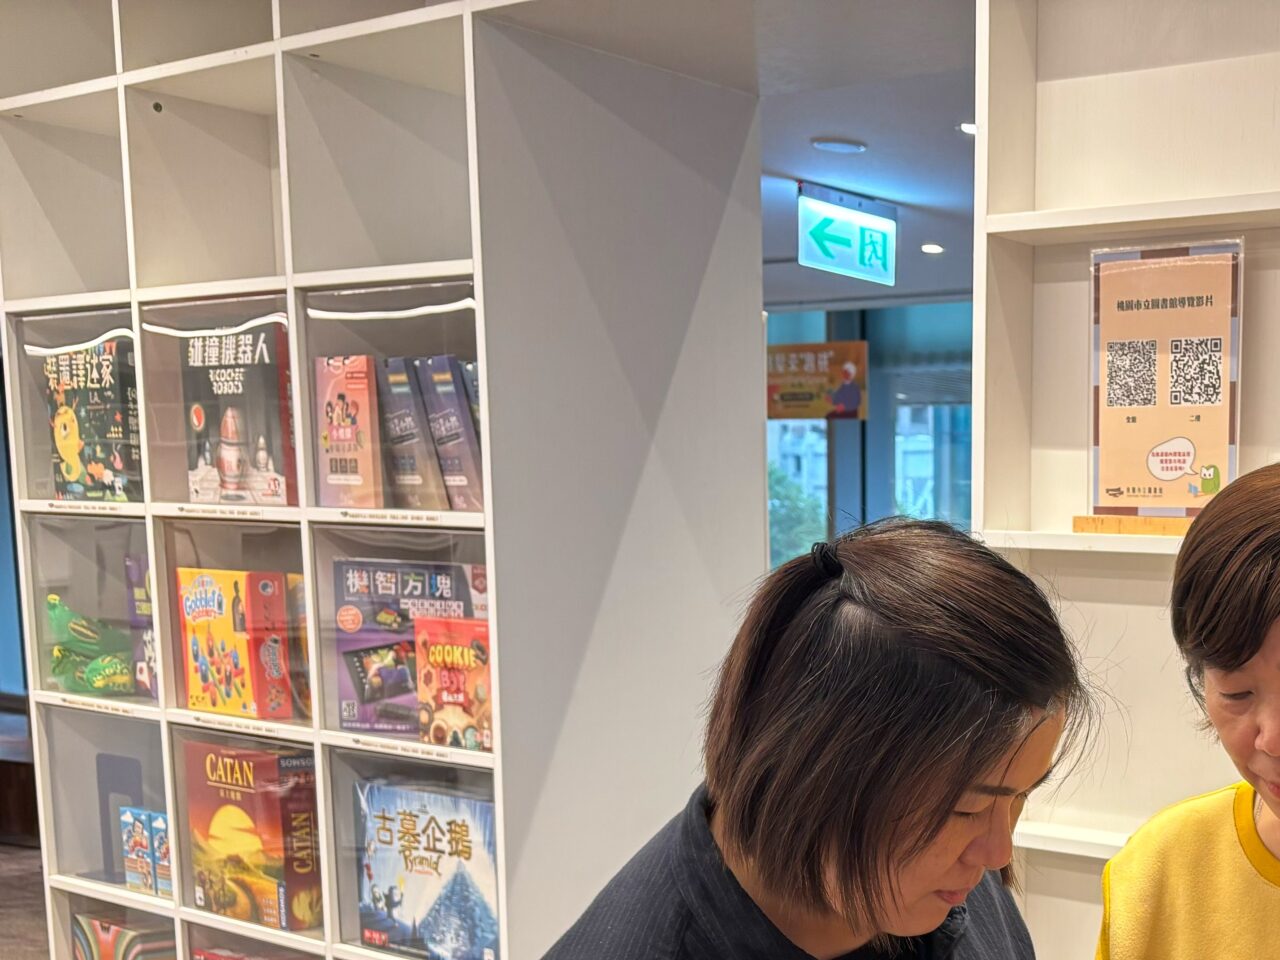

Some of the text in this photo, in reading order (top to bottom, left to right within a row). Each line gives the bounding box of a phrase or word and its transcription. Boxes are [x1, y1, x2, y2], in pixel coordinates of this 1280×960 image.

[346, 569, 451, 597] 機智方塊
[429, 645, 476, 668] COOKIE
[206, 753, 254, 787] CATAN
[291, 812, 314, 874] CATAN
[374, 808, 472, 861] 古墓企鵝
